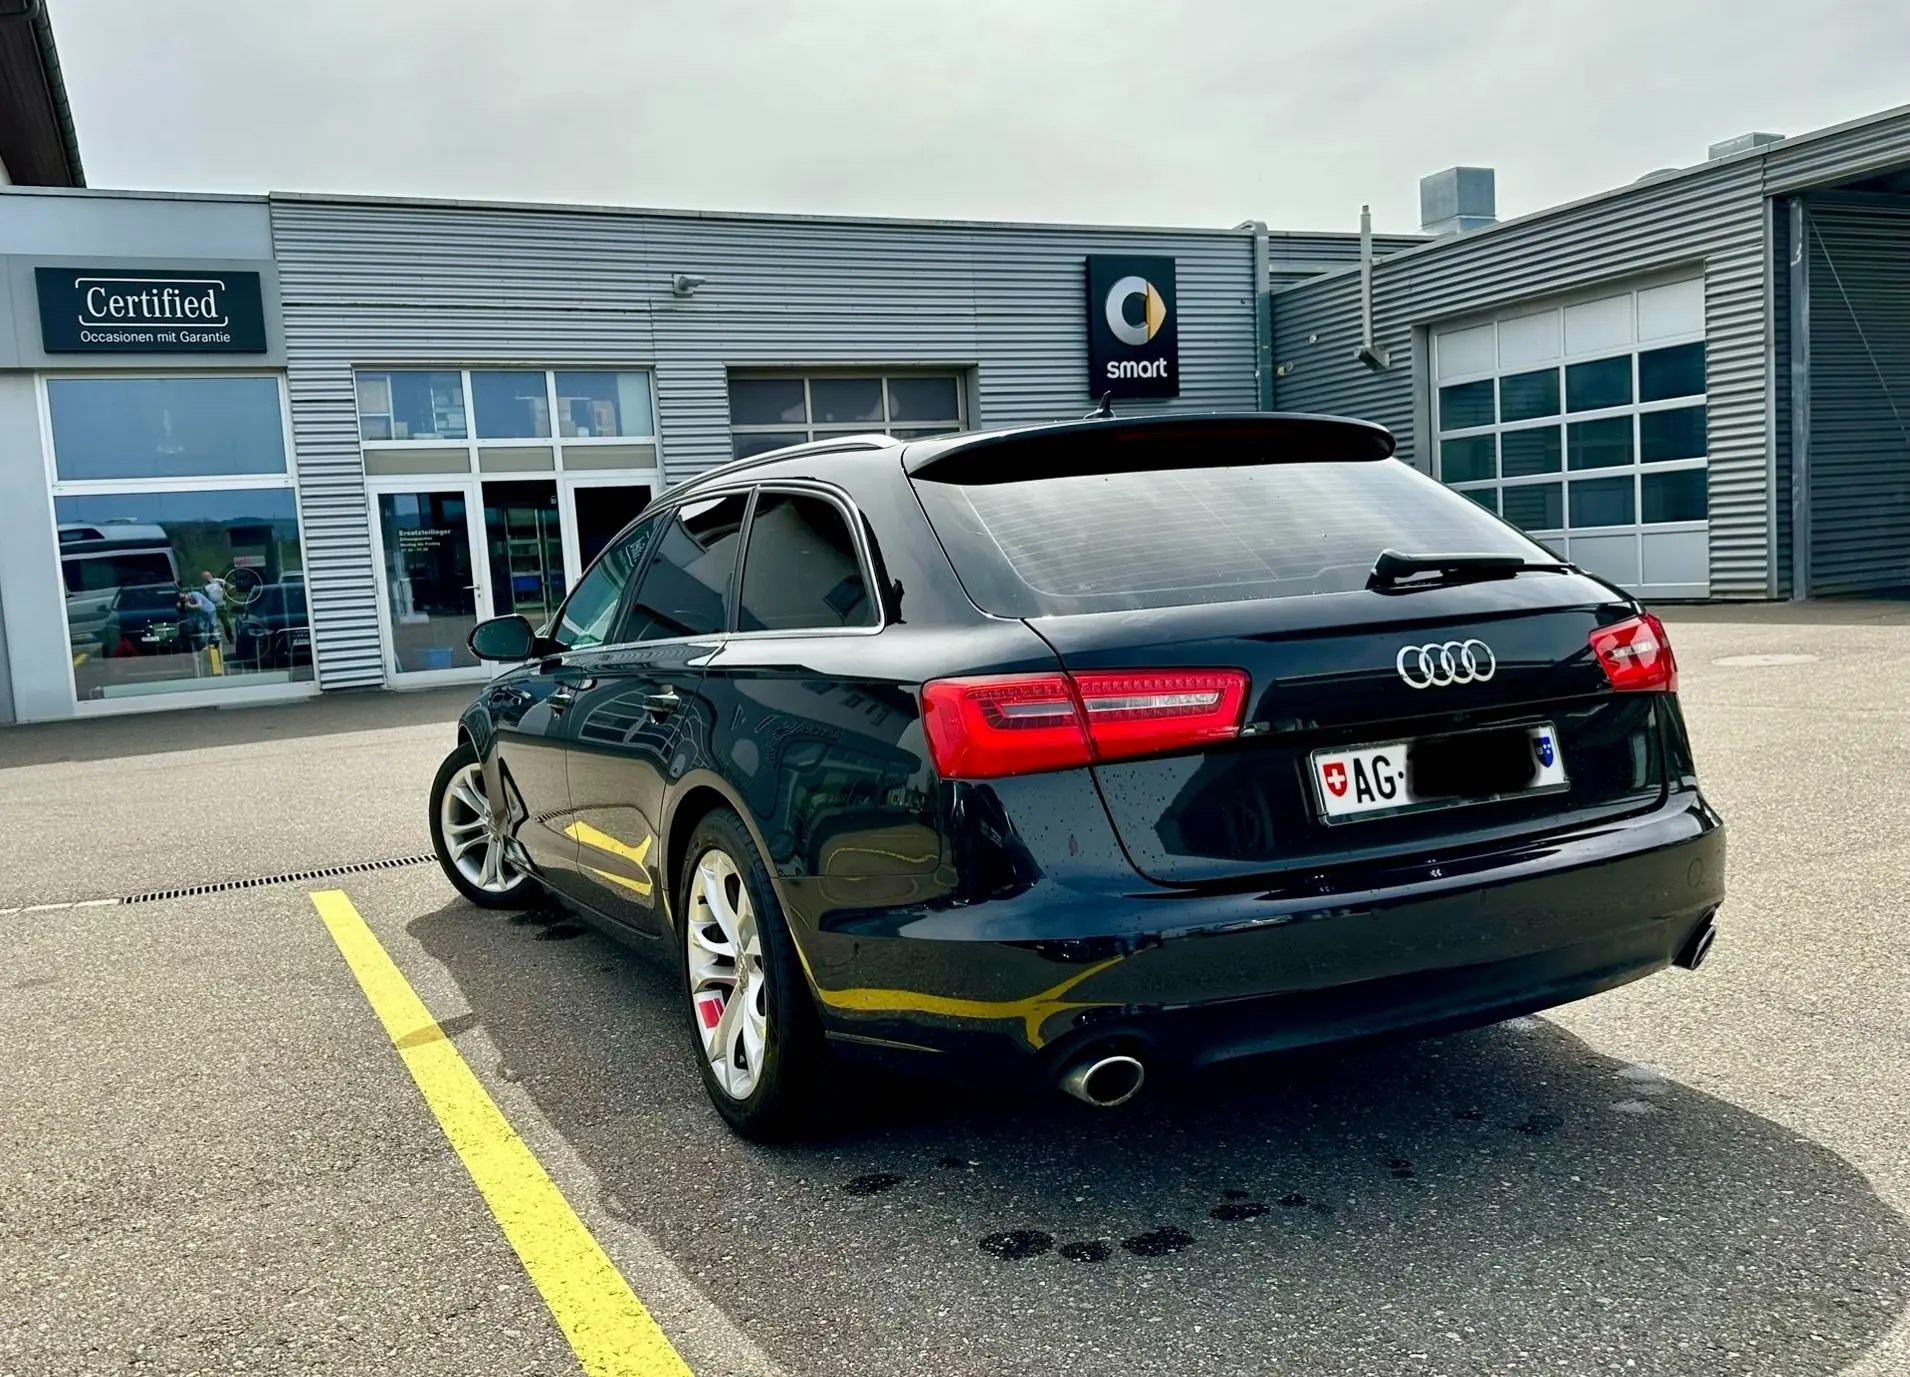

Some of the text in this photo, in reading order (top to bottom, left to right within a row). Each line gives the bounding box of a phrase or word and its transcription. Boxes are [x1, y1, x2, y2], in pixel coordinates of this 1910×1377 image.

[86, 286, 219, 318] Certified
[80, 330, 231, 343] Occasionen mit Garantie
[1106, 357, 1168, 379] smart
